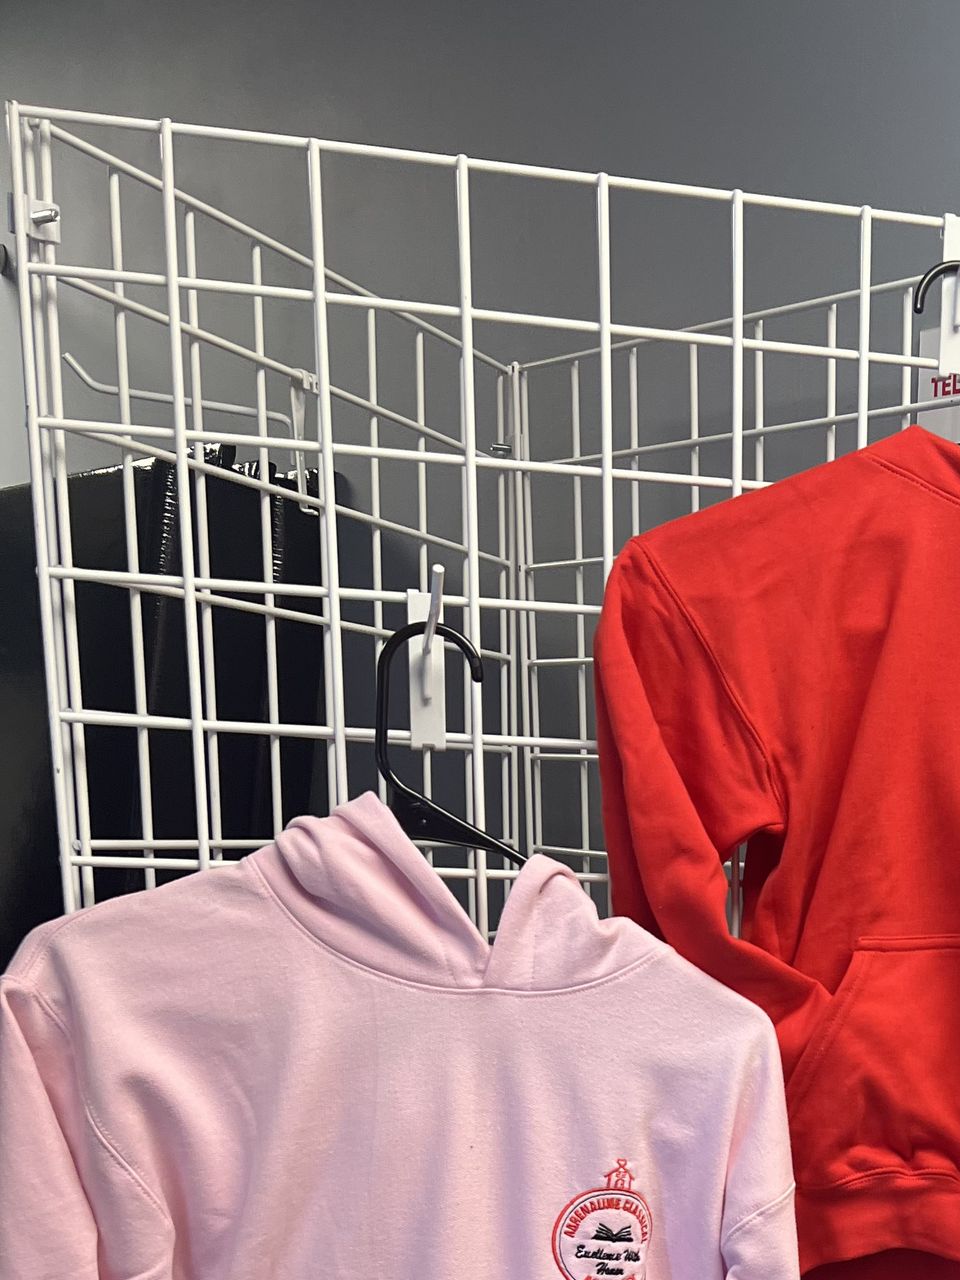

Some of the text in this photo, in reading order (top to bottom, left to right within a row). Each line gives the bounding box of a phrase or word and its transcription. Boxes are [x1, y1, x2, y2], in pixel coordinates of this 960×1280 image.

[564, 1198, 649, 1244] ADRENALINE CLASSICAL
[575, 1244, 622, 1262] Excellence
